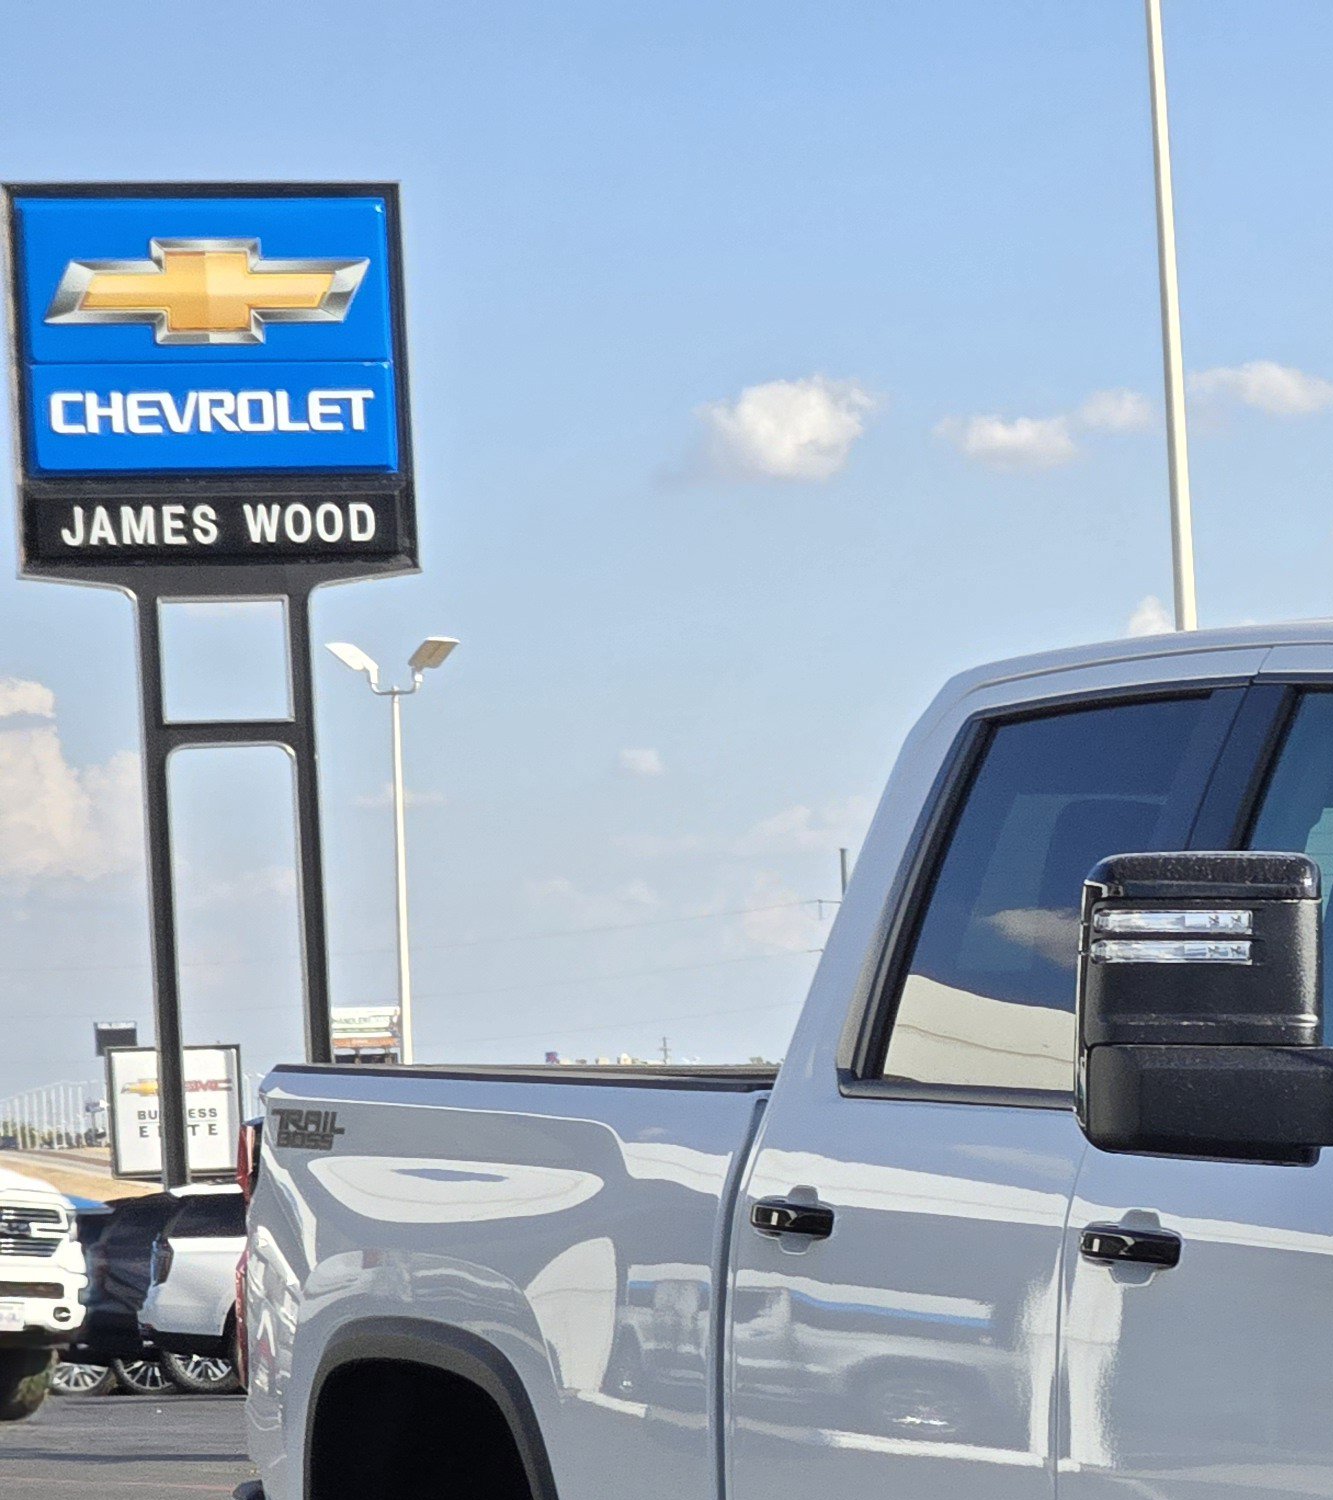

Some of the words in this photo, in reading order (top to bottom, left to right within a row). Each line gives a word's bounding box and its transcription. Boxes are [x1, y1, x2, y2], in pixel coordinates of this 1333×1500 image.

[50, 389, 374, 434] CHEVROLET
[61, 504, 219, 546] JAMES
[243, 502, 377, 544] WOOD
[137, 1108, 218, 1120] BUESS
[271, 1108, 345, 1134] TRAIL
[139, 1123, 218, 1138] ETE
[276, 1132, 335, 1151] BOSS
